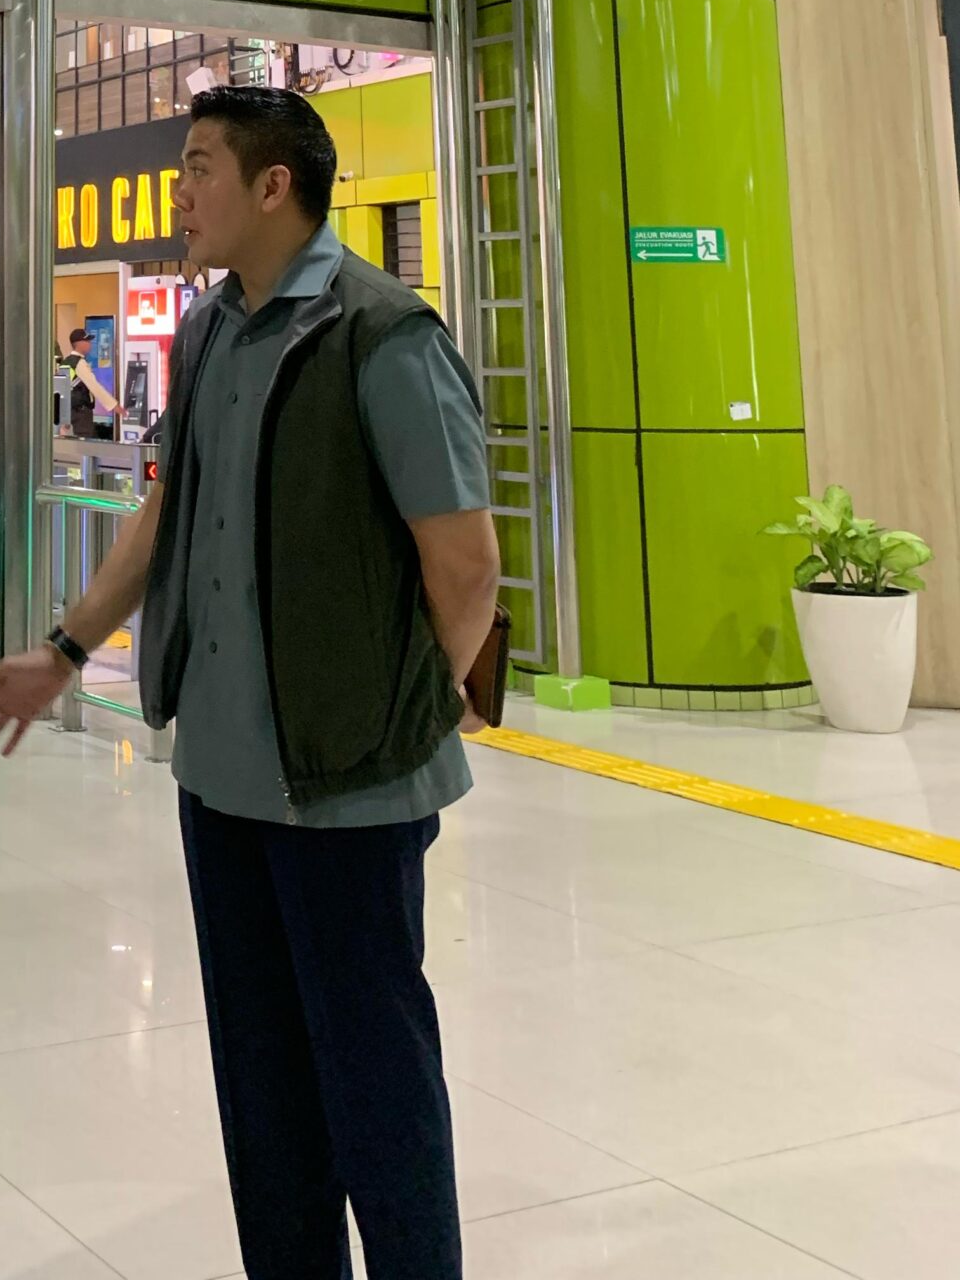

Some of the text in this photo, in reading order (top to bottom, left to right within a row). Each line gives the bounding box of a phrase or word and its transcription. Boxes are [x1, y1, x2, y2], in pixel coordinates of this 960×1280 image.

[57, 169, 179, 249] KO CAF
[635, 231, 693, 239] JALUR EVAKUASI
